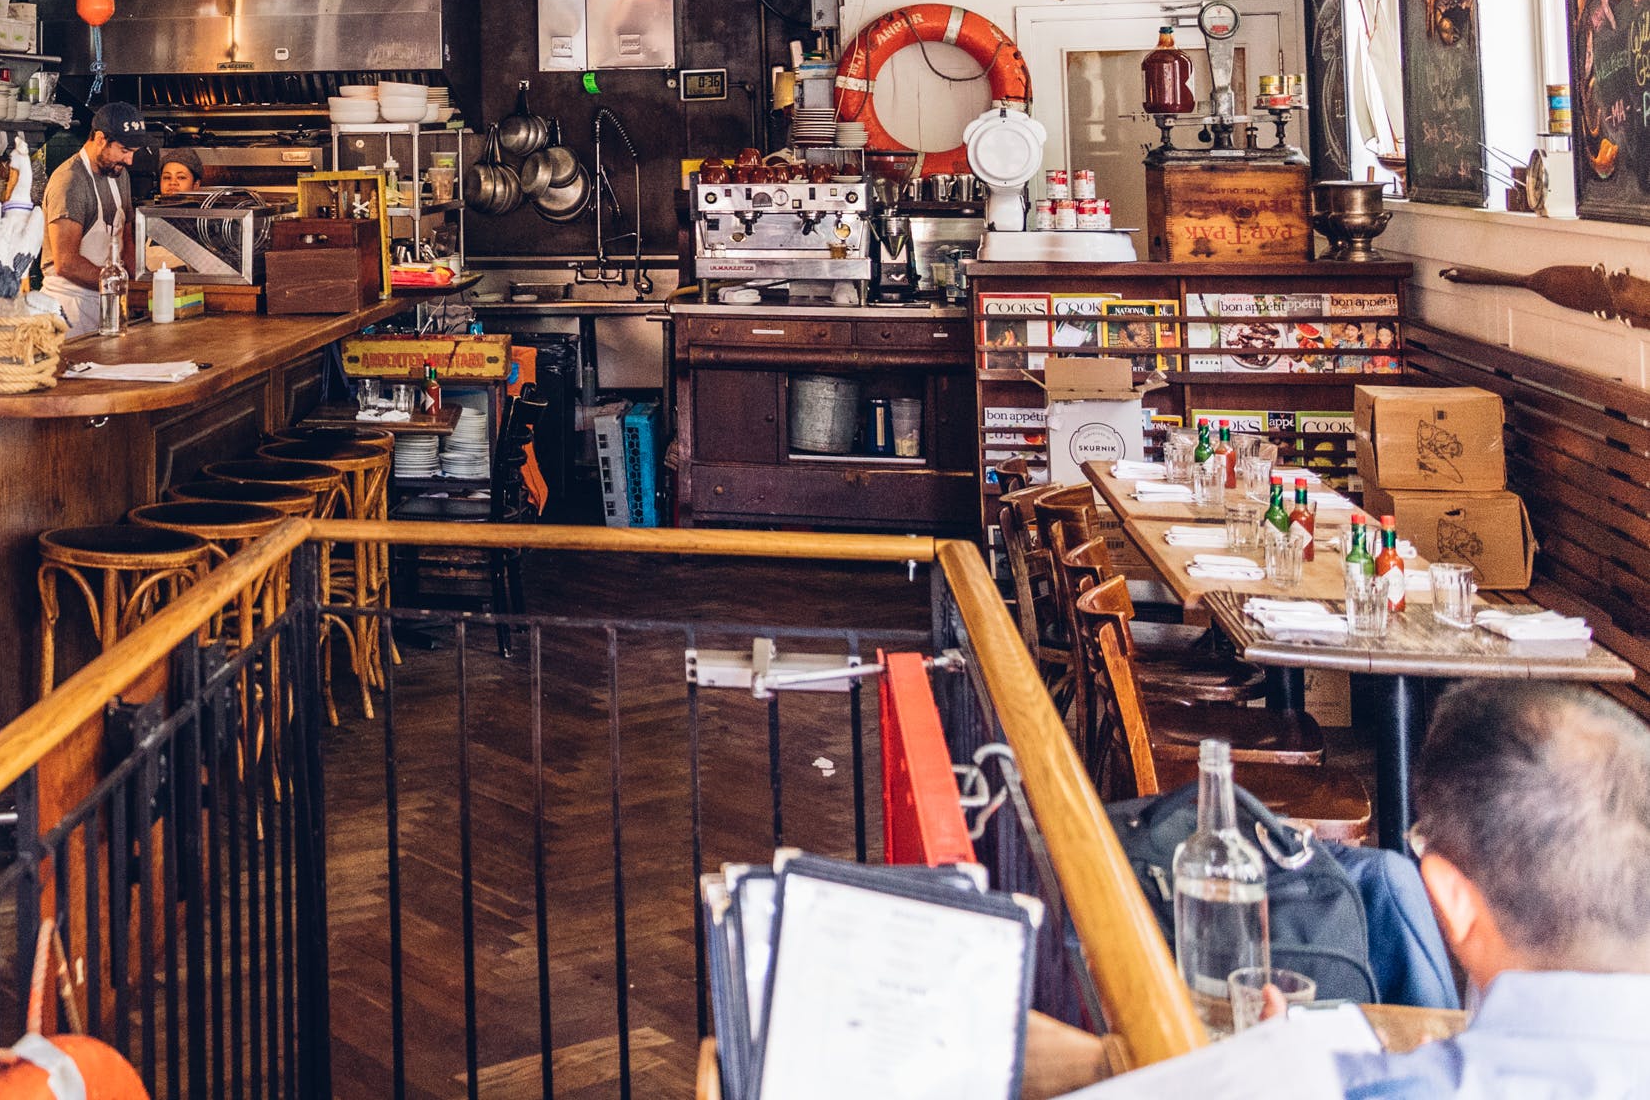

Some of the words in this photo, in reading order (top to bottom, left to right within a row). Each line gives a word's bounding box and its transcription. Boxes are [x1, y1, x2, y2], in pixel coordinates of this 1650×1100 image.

[1221, 301, 1243, 311] bon
[1244, 300, 1286, 314] appétit
[1331, 296, 1353, 307] bon
[1355, 296, 1396, 309] appétit
[985, 303, 1046, 314] COOK'S
[1115, 307, 1147, 315] NATIONAL
[986, 410, 1008, 420] bon
